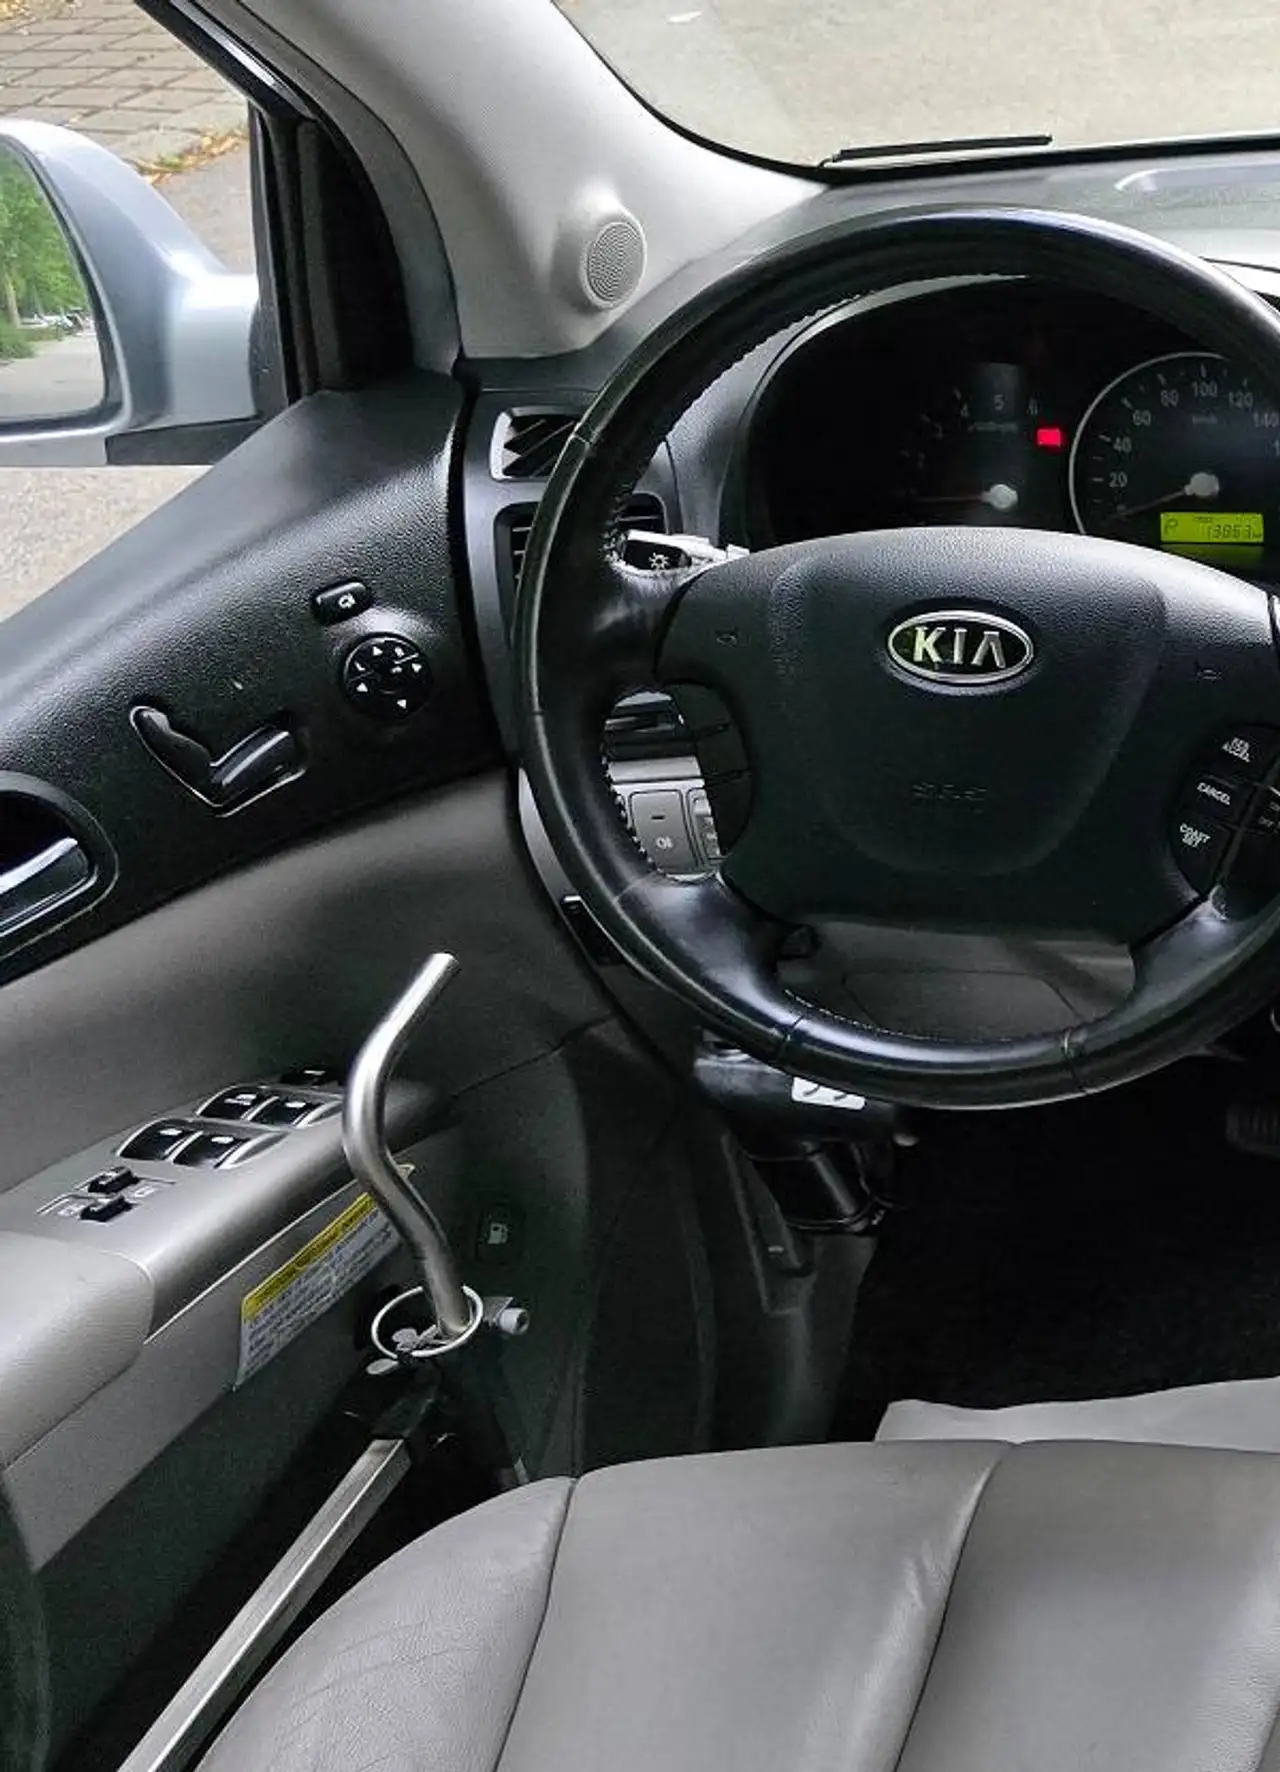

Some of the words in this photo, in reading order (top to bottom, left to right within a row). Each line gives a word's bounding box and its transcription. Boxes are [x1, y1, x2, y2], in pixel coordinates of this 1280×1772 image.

[1193, 381, 1218, 398] 100
[1228, 392, 1254, 408] 120
[1253, 411, 1280, 428] 140
[1113, 438, 1132, 453] 40
[1109, 472, 1128, 488] 20
[912, 624, 1006, 669] KIA
[1197, 782, 1231, 805] CANCEL
